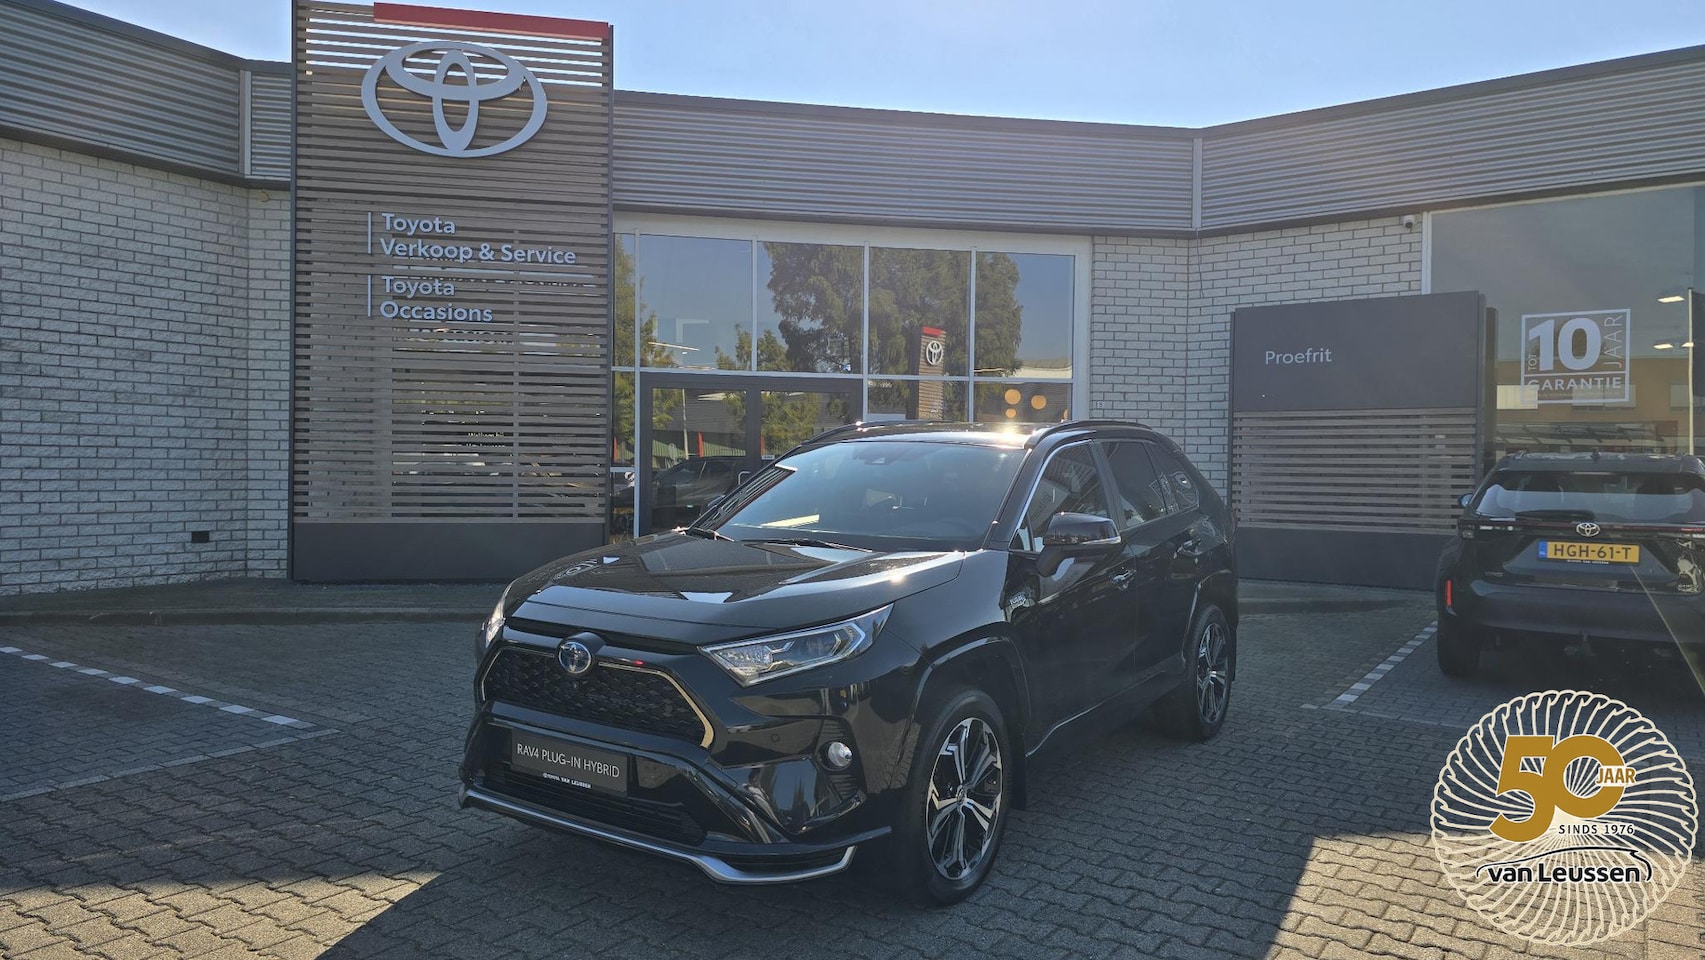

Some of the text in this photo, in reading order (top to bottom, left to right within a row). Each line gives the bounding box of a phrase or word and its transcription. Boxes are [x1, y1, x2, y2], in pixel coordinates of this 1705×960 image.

[381, 212, 456, 236] Toyota
[380, 238, 576, 264] Verkoop & Service
[381, 275, 456, 298] Toyota
[380, 301, 493, 322] Occasions
[1528, 317, 1602, 371] TOT 10
[1603, 314, 1623, 369] JAAR
[1265, 347, 1332, 365] Proefrit
[1527, 376, 1622, 391] GARANTIE
[1553, 543, 1632, 560] HGH-61-T
[517, 743, 620, 778] RAV4 PLUG-IN HYBRID
